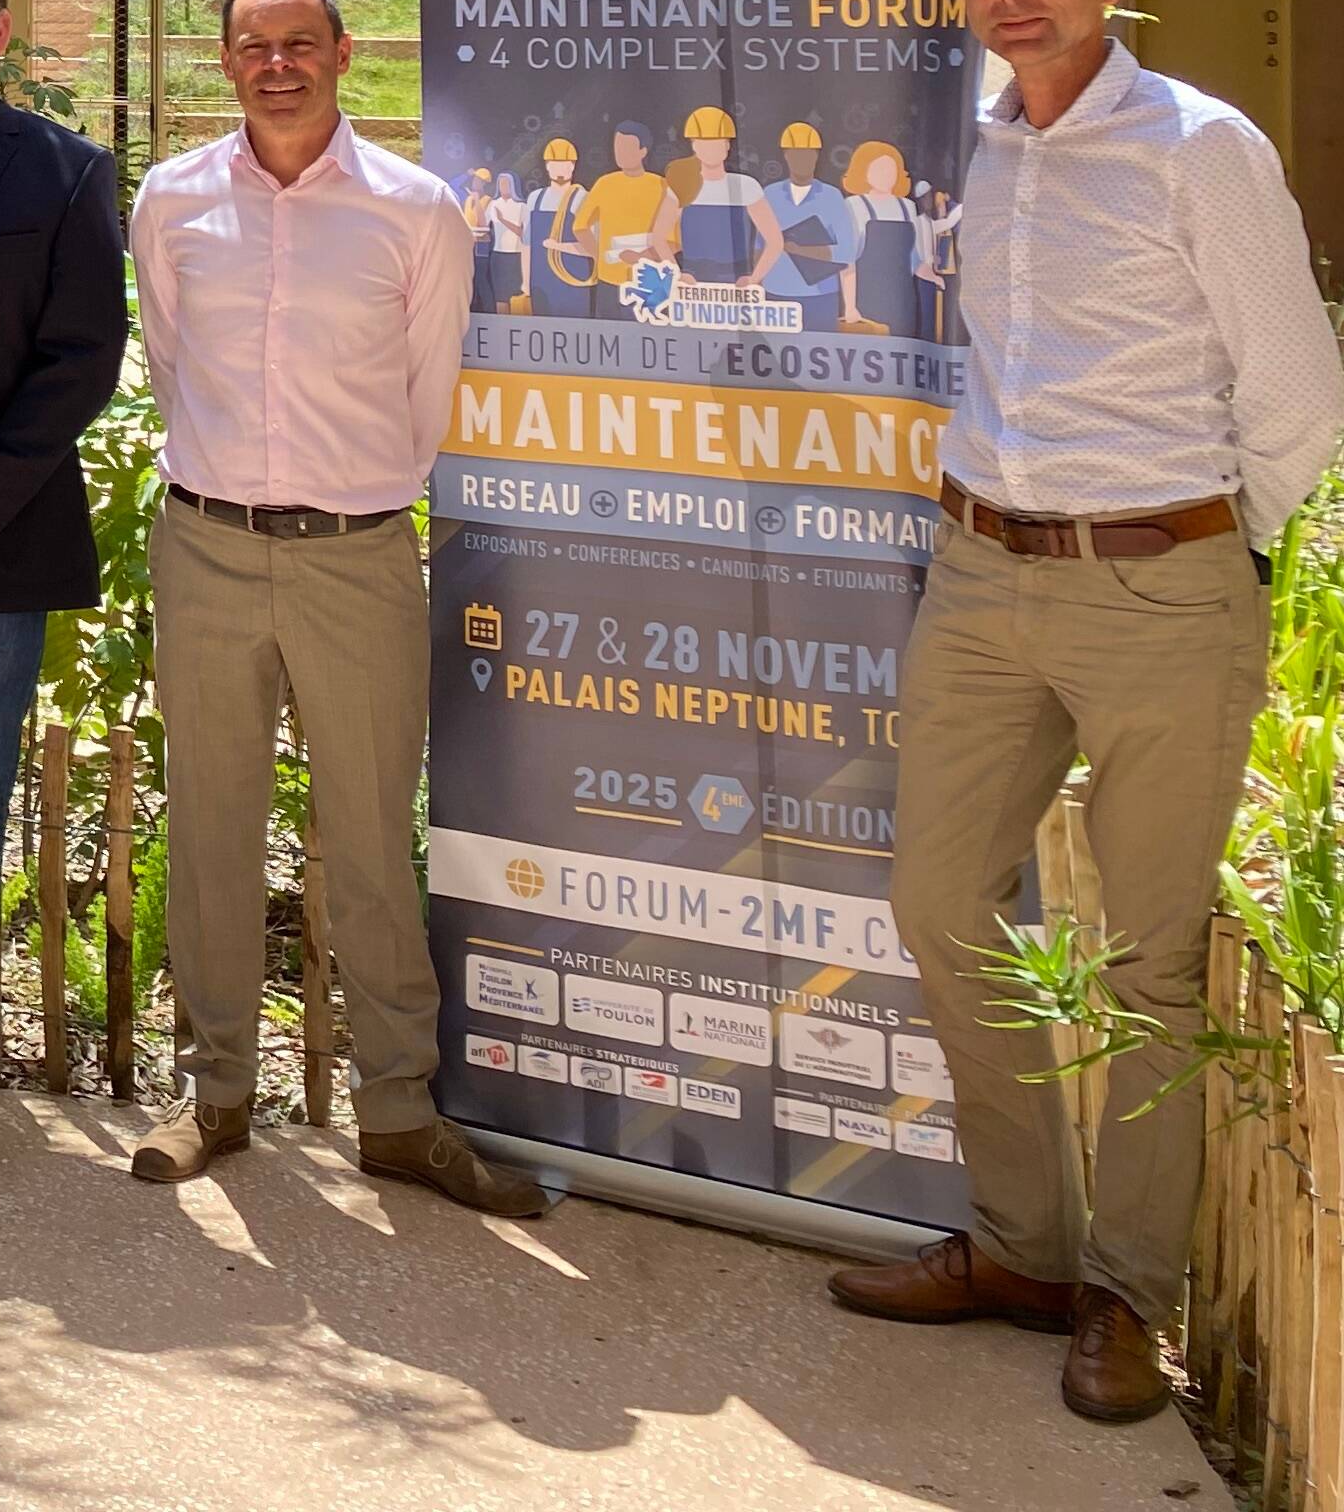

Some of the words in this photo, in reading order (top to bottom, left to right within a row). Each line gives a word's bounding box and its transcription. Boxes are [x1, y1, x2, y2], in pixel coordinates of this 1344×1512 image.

[489, 37, 510, 70] 4
[527, 37, 727, 71] COMPLEX
[743, 37, 941, 72] SYSTEMS
[673, 301, 797, 328] D'INDUSTRIE
[678, 286, 760, 304] TERRITOIRES
[462, 327, 489, 359] E
[509, 329, 620, 367] FORUM
[642, 337, 678, 372] DE
[698, 341, 965, 396] L'ECOSYSTEME
[462, 474, 581, 516] RESEAU
[627, 489, 746, 533] EMPLOI
[795, 505, 940, 554] FORMATI
[465, 532, 547, 559] EXPOSANTS
[568, 543, 680, 572] CONFERENCES
[701, 556, 790, 584] CANDIDATS
[814, 568, 908, 594] ETUDIANTS
[525, 610, 580, 660] 27
[596, 616, 627, 665] &
[644, 621, 700, 674] 28
[506, 664, 641, 715] PALAIS
[655, 681, 846, 748] NEPTUNE,
[574, 765, 678, 810] 2025
[762, 785, 897, 843] ÉDITION
[550, 948, 693, 989] PARTENAIRES
[699, 974, 900, 1027] INSTITUTIONNELS
[593, 1007, 656, 1028] TOULON
[703, 1015, 767, 1038] MARINE
[520, 1033, 594, 1057] PARTENAIRES
[596, 1049, 680, 1074] STRATEGIQUES
[703, 1031, 767, 1050] NATIONALE
[687, 1084, 736, 1105] EDEN
